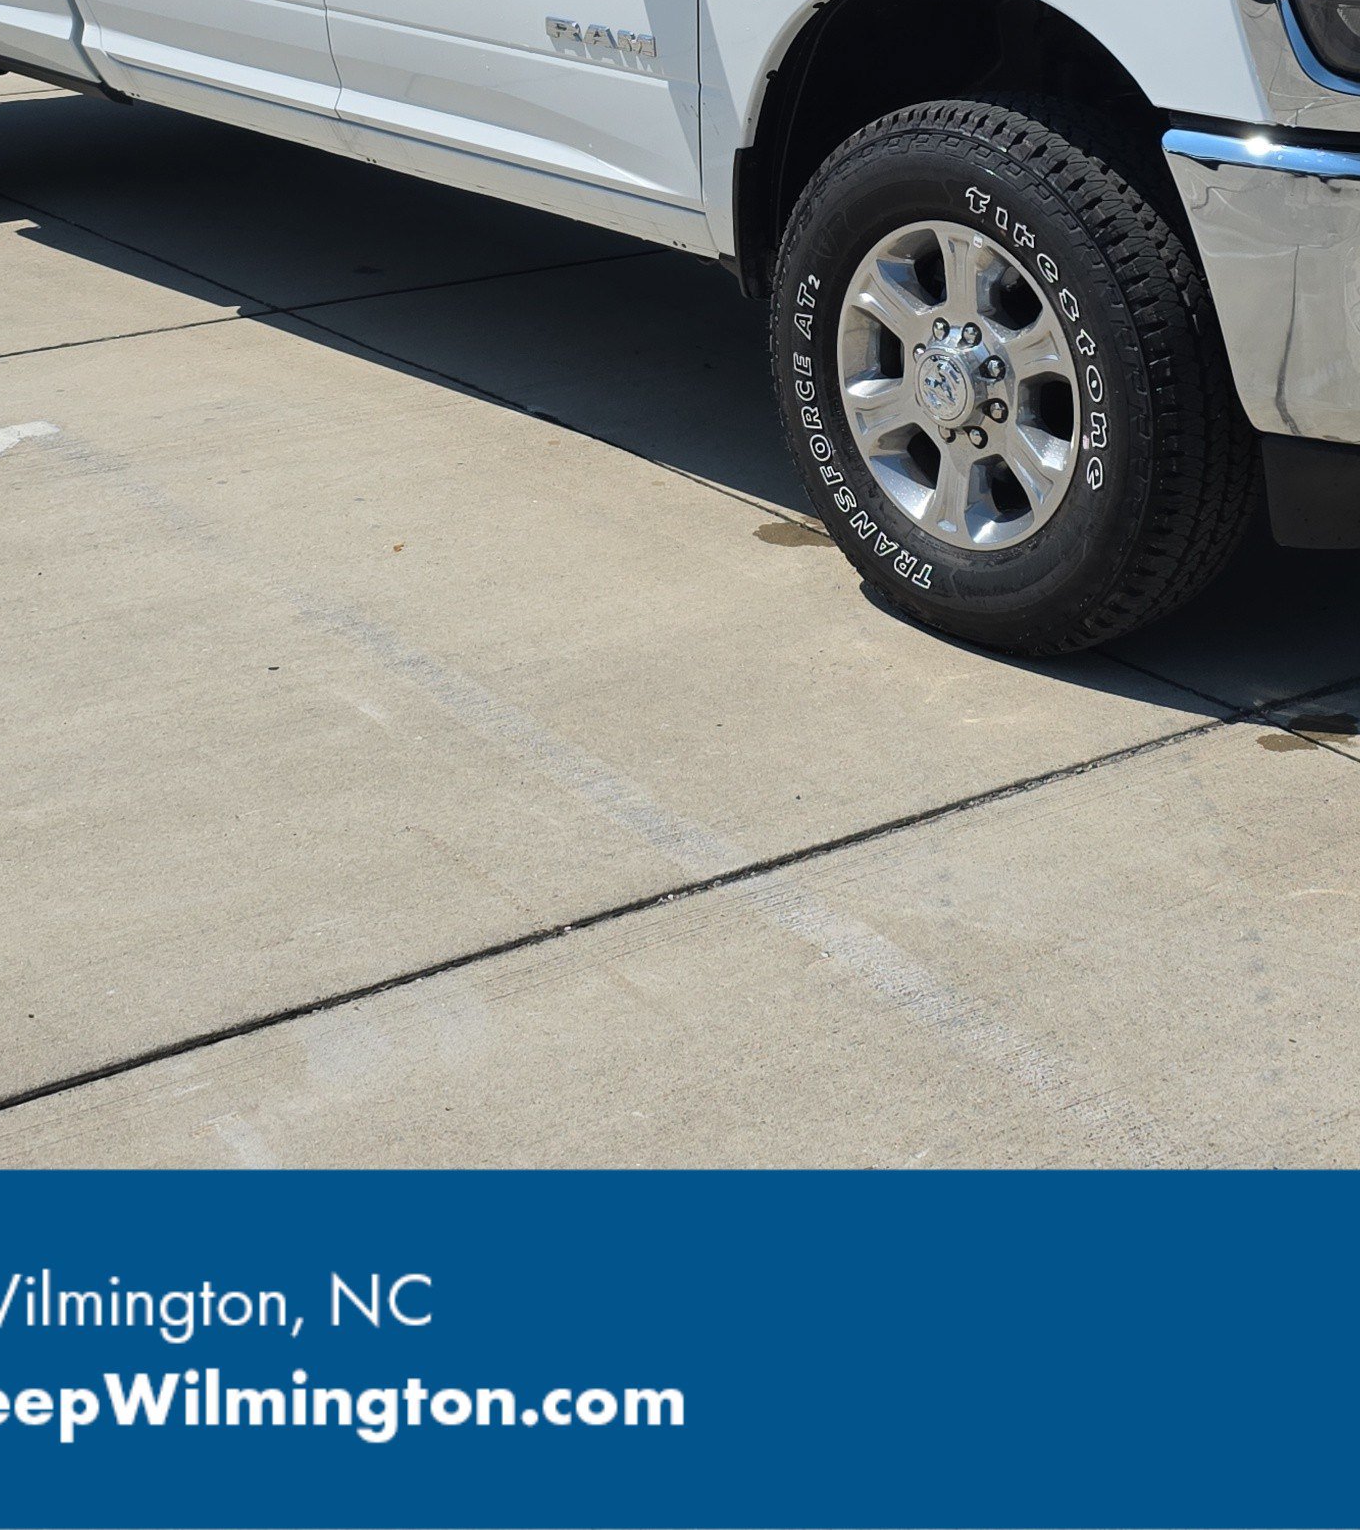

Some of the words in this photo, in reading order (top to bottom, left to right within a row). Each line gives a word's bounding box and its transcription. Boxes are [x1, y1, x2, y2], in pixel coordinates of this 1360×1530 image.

[545, 16, 657, 58] RAM
[966, 187, 1108, 490] Firestone
[793, 351, 933, 589] TRANSFORCE
